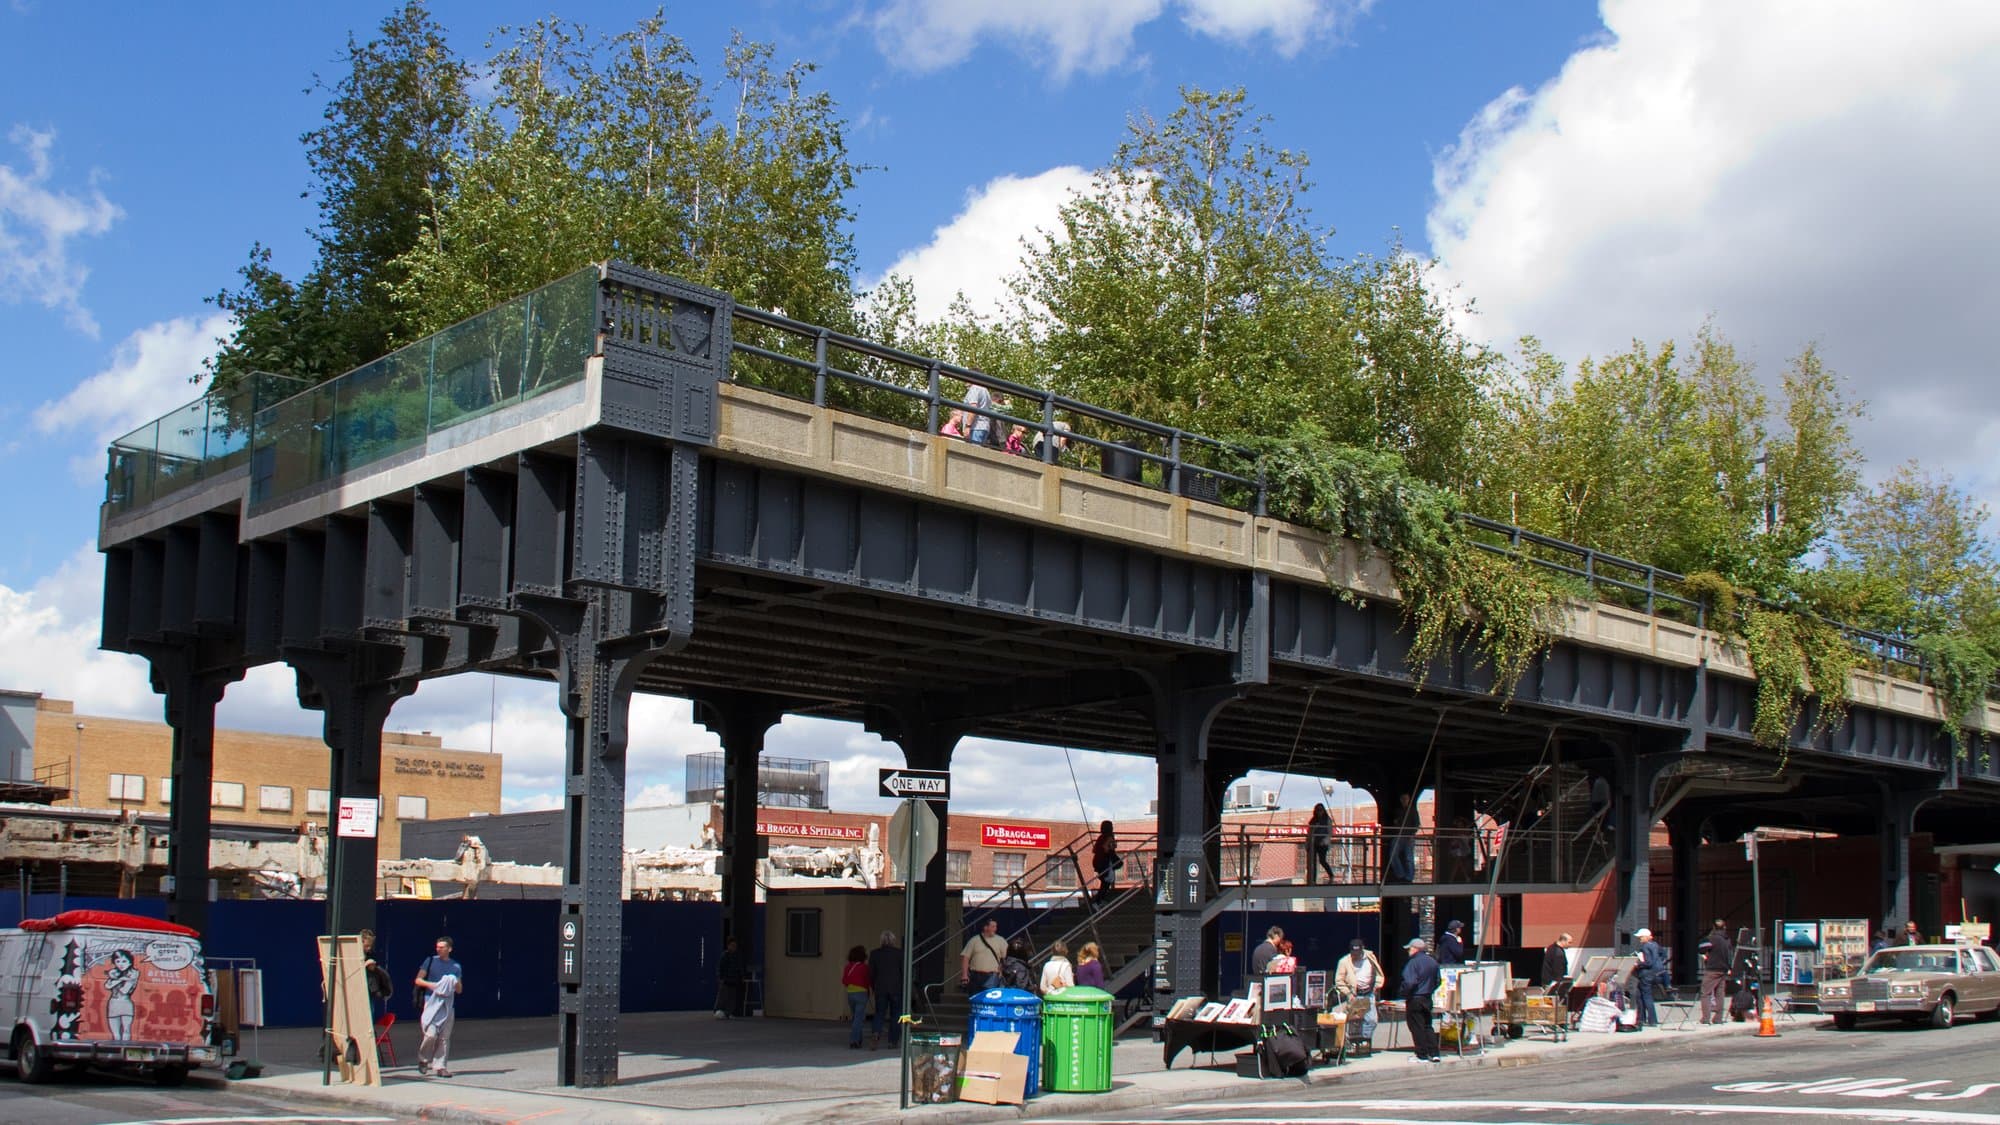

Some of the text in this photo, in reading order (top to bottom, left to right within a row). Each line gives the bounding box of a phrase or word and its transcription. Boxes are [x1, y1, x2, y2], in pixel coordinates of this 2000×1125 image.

[394, 757, 410, 767] THE
[412, 758, 429, 768] CITY
[431, 760, 442, 769] OF
[445, 761, 462, 770] NEW
[891, 777, 942, 791] ONE WAY
[341, 808, 352, 817] NO
[766, 824, 800, 835] BRAGGA
[800, 825, 809, 835] &
[845, 828, 862, 838] INC.
